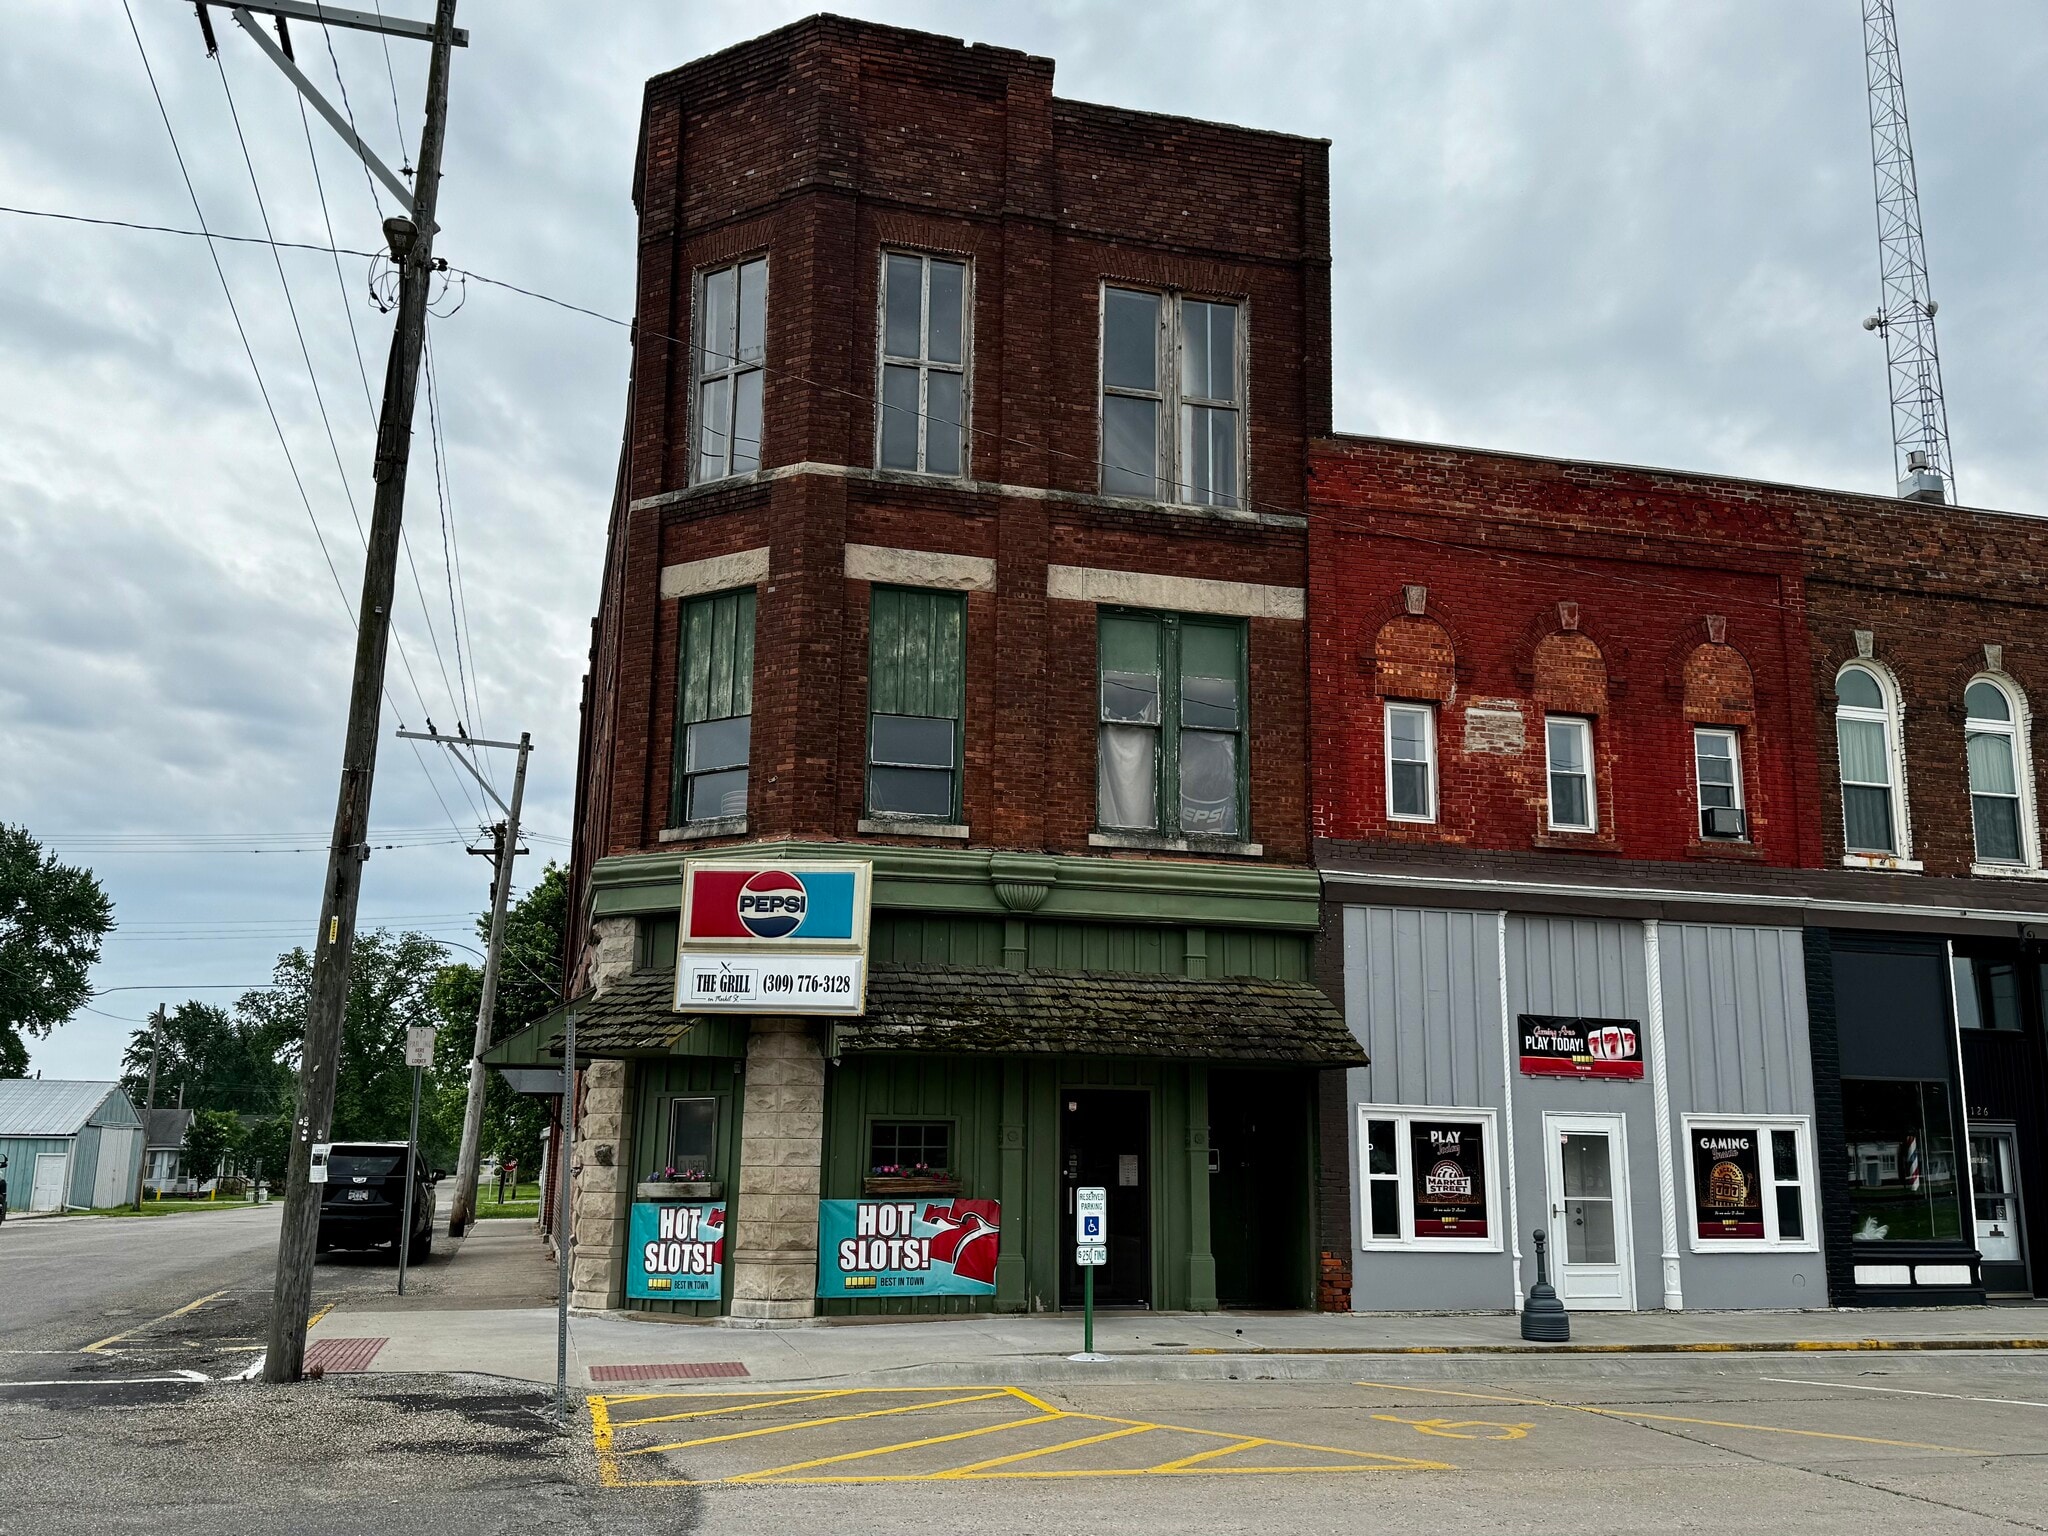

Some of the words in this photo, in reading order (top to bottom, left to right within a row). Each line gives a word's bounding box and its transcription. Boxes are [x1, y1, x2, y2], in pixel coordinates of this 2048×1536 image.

[1183, 807, 1225, 823] EPSI
[740, 896, 806, 913] PEPSI
[697, 974, 717, 992] THE
[720, 974, 751, 993] GRILL
[763, 974, 794, 994] (309)
[797, 975, 851, 993] 776-3128
[1525, 1036, 1548, 1050] PLAY
[1551, 1037, 1584, 1051] TODAY!
[1971, 1106, 1989, 1116] 126
[1430, 1131, 1460, 1143] PLAY
[1701, 1138, 1749, 1150] GAMING
[1428, 1178, 1469, 1186] MARKET
[660, 1207, 702, 1240] HOT
[857, 1204, 915, 1236] HOT
[644, 1242, 714, 1274] SLOTS!
[840, 1239, 930, 1271] SLOTS!
[1094, 1250, 1105, 1260] FINE
[674, 1281, 687, 1290] BEST
[687, 1281, 693, 1289] IN
[694, 1281, 709, 1289] TOWN
[880, 1278, 896, 1286] BEST
[898, 1277, 905, 1286] IN
[906, 1277, 925, 1286] TOWN
